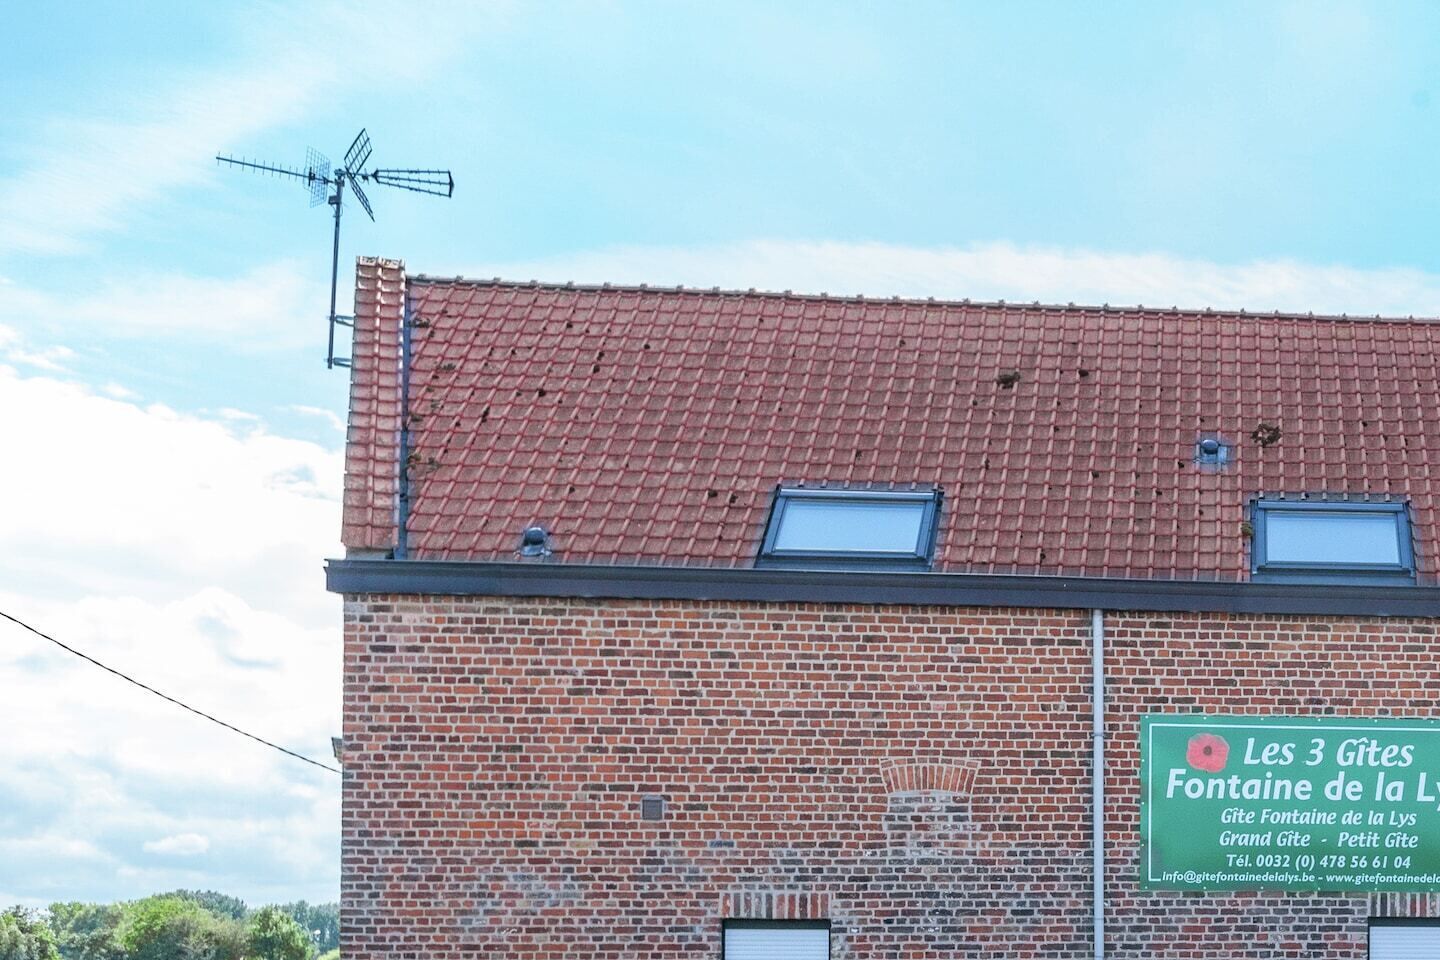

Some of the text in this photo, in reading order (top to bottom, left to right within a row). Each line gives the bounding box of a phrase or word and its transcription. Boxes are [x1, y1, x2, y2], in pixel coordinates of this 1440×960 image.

[1243, 736, 1415, 768] Les 3 Gîtes
[1165, 768, 1313, 801] Fontaine
[1324, 771, 1364, 801] de
[1375, 772, 1405, 802] la
[1220, 806, 1417, 828] Gîte Fontaine de la Lys
[1218, 830, 1272, 848] Grand
[1276, 831, 1311, 848] Gîte
[1337, 832, 1381, 849] Petit
[1384, 832, 1419, 849] Gîte
[1226, 853, 1411, 871] Tél. 0032 (0) 478 56 61 04
[1161, 870, 1316, 885] info@gitefontainedelalys.be
